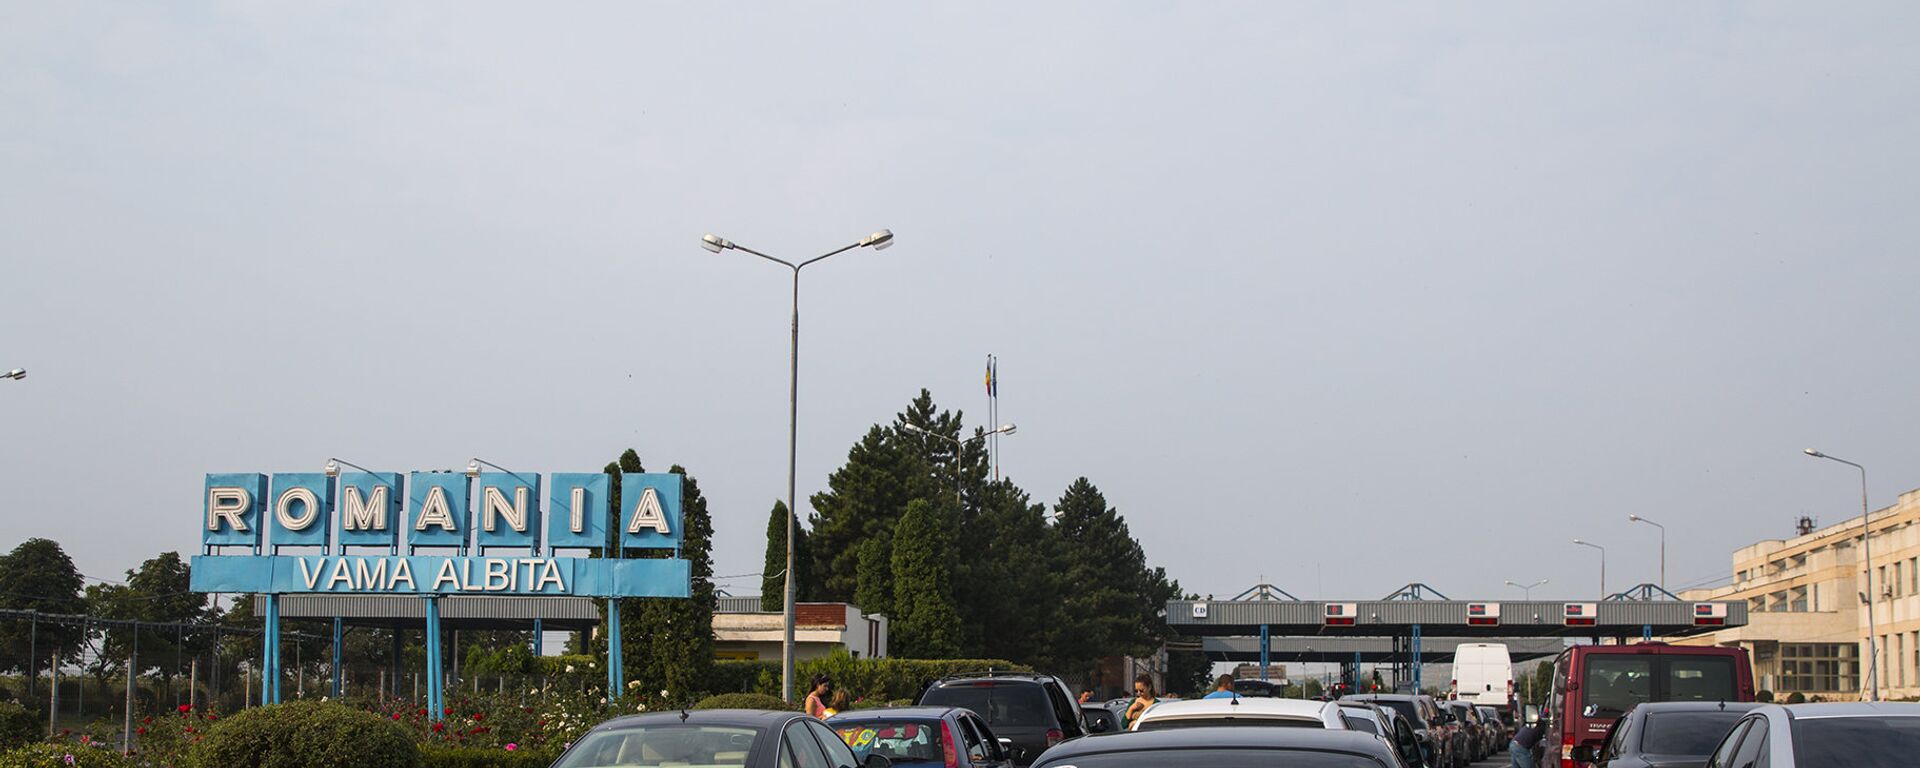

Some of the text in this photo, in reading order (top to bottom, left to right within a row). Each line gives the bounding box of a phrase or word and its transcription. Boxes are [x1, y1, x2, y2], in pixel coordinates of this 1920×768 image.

[208, 485, 671, 534] ROMANIA
[299, 557, 565, 592] VAMA ALBITA
[1194, 606, 1206, 614] CD
